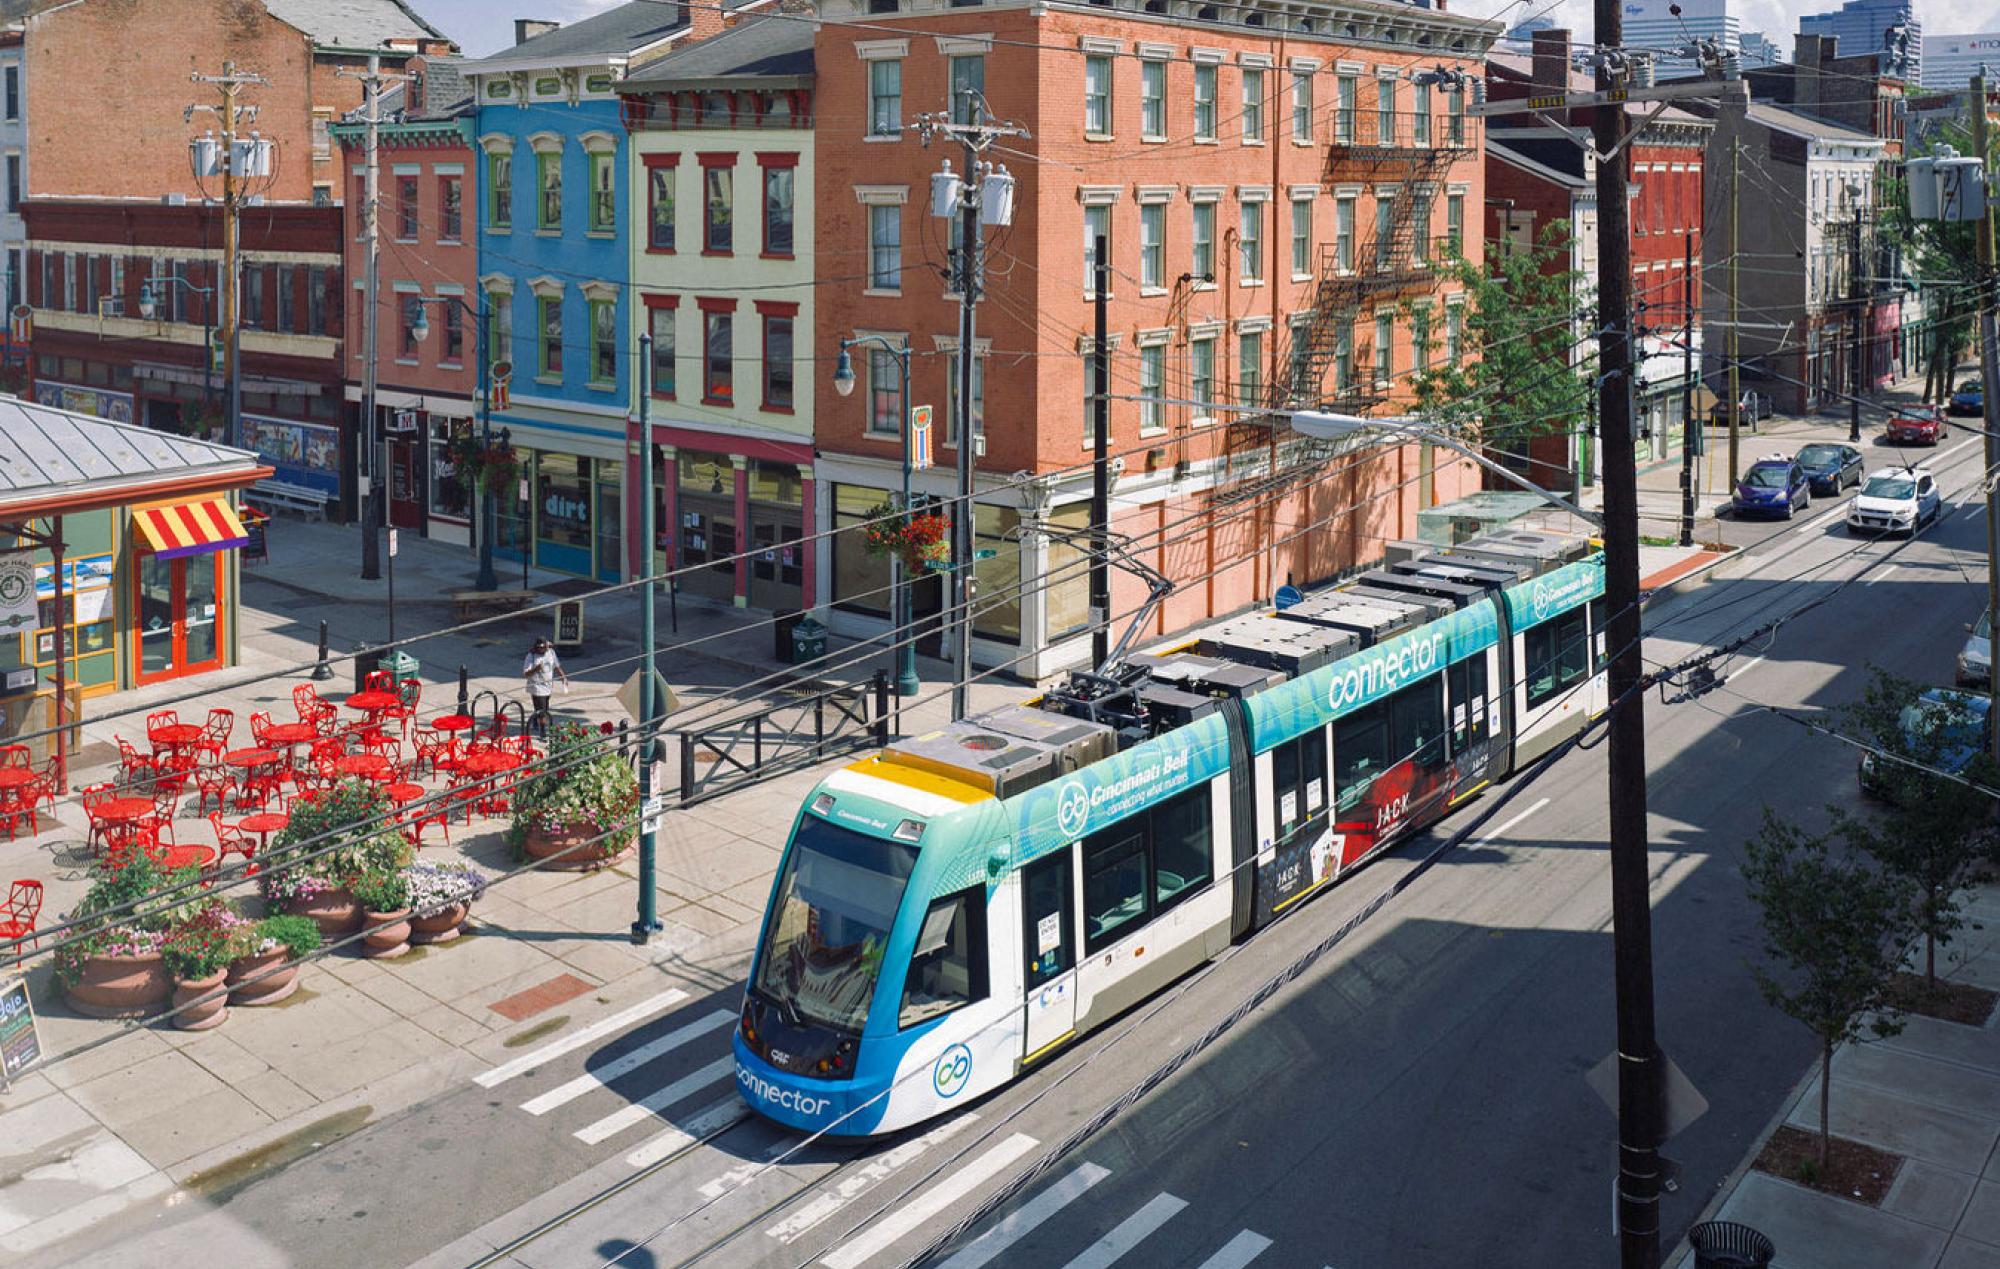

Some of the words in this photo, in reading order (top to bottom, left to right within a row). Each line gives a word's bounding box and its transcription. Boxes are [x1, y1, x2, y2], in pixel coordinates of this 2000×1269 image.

[545, 495, 587, 521] dirt
[1328, 633, 1442, 710] connector
[1091, 764, 1161, 806] Cincinnati
[1163, 749, 1188, 775] Bell
[1376, 792, 1410, 830] JACK
[1276, 864, 1300, 887] JACK
[735, 1062, 831, 1115] connector
